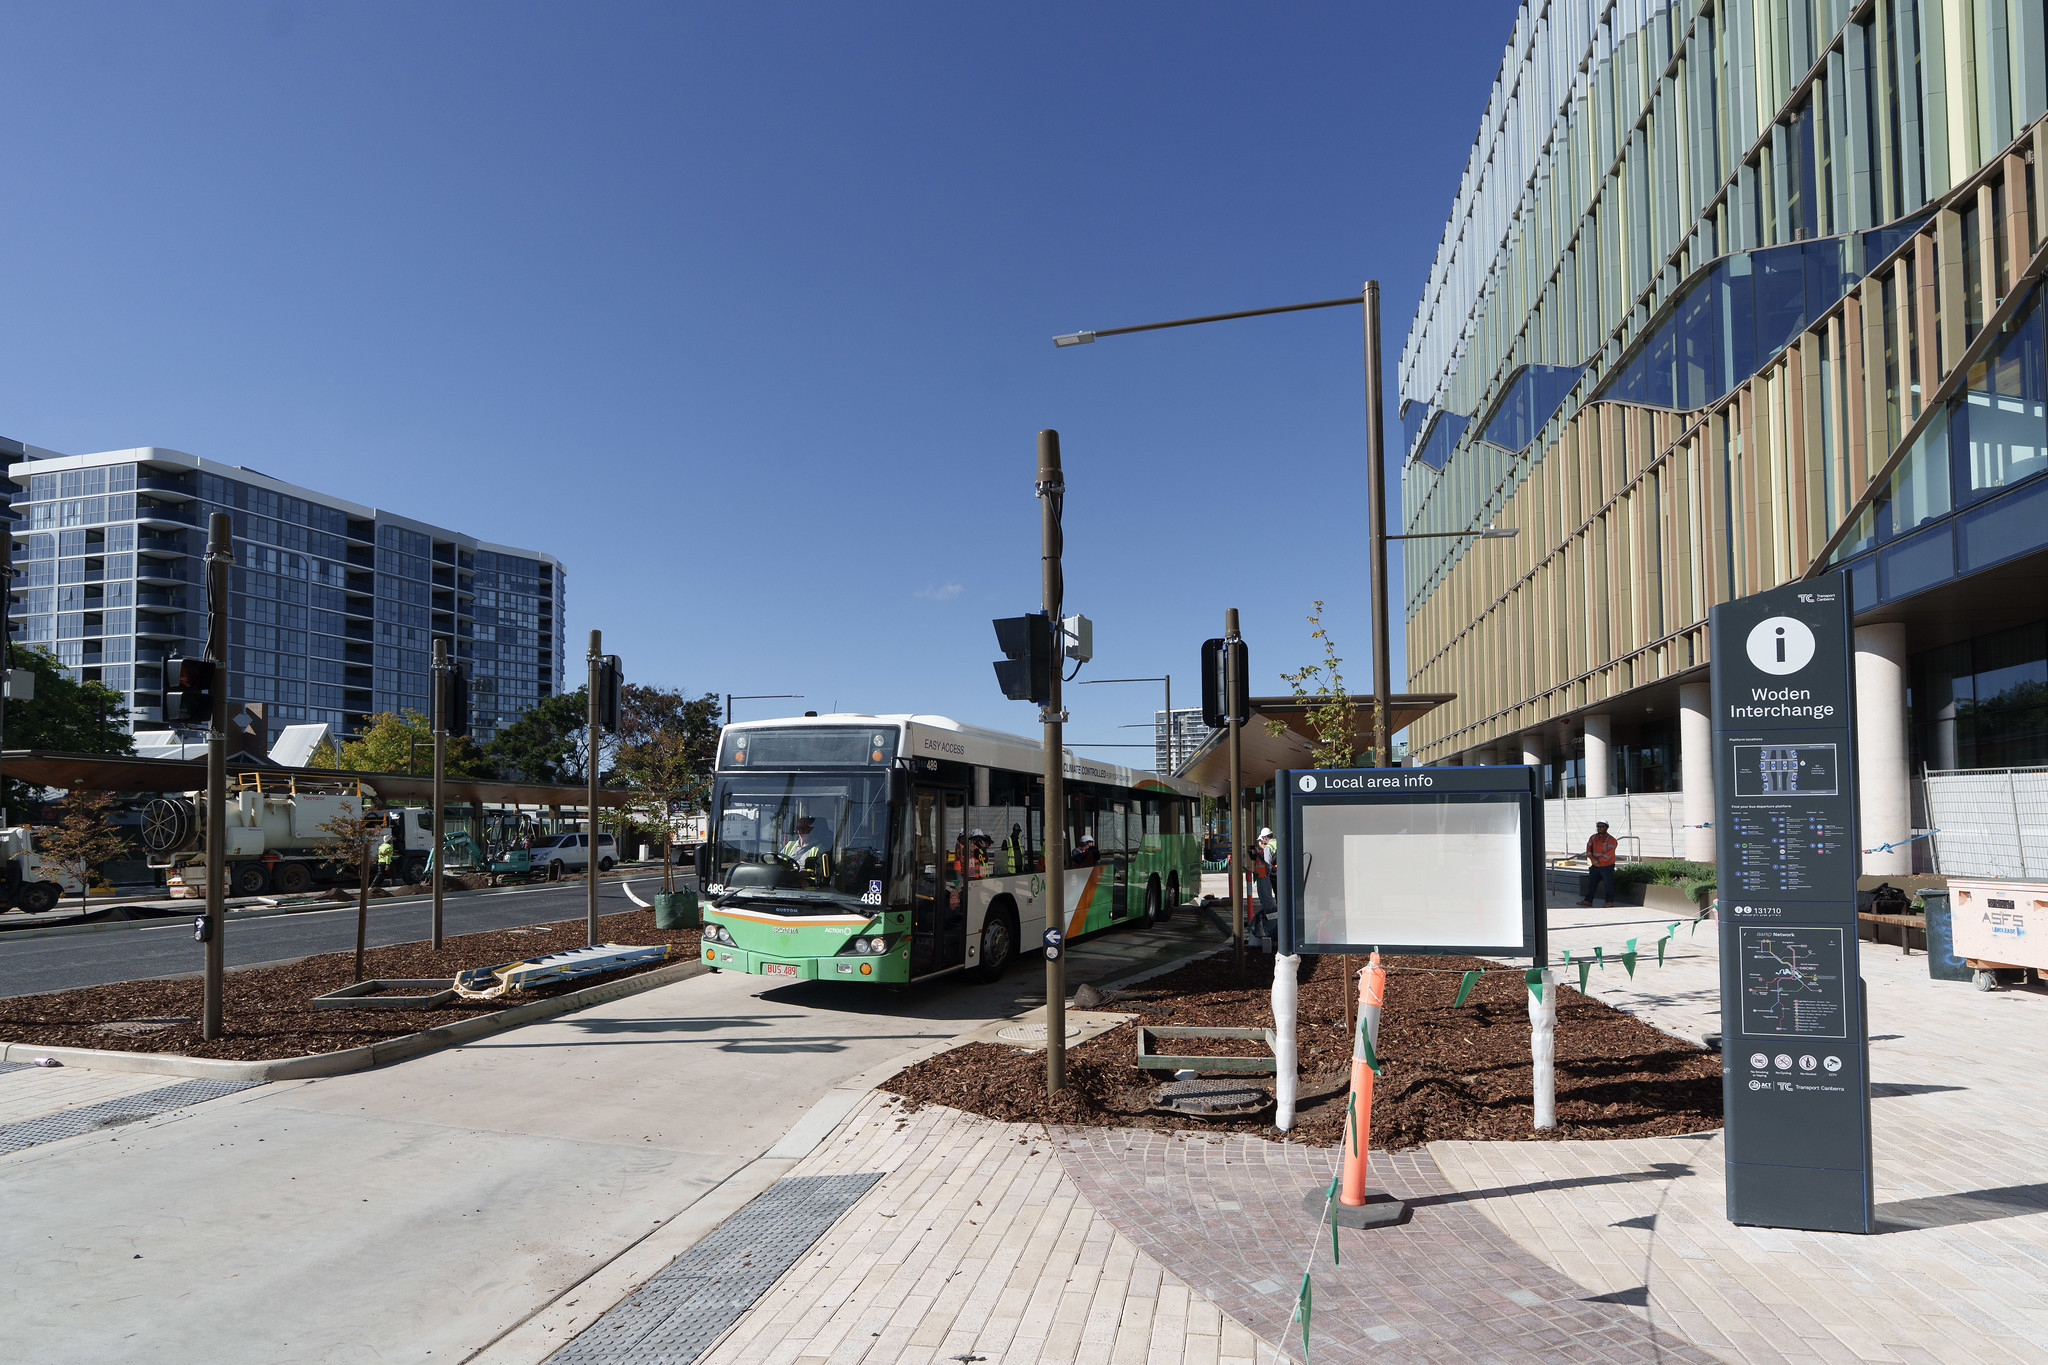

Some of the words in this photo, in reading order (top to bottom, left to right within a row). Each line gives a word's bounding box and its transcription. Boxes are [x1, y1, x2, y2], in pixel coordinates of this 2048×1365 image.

[1797, 593, 1815, 603] TC
[1752, 687, 1810, 701] Woden
[1731, 704, 1834, 719] Interchange
[924, 739, 941, 752] EASY
[941, 743, 965, 756] ACCESS
[926, 760, 938, 771] 489
[1063, 762, 1081, 775] CLIMATE
[1081, 766, 1106, 779] CONTROLLED
[1324, 774, 1364, 789] Local
[1367, 777, 1400, 788] area
[1403, 774, 1433, 787] info
[707, 883, 724, 895] 489
[861, 893, 882, 905] 489
[1982, 912, 2024, 927] ASFS
[767, 963, 782, 974] BUS
[783, 965, 796, 975] 489
[1776, 1081, 1794, 1092] TC
